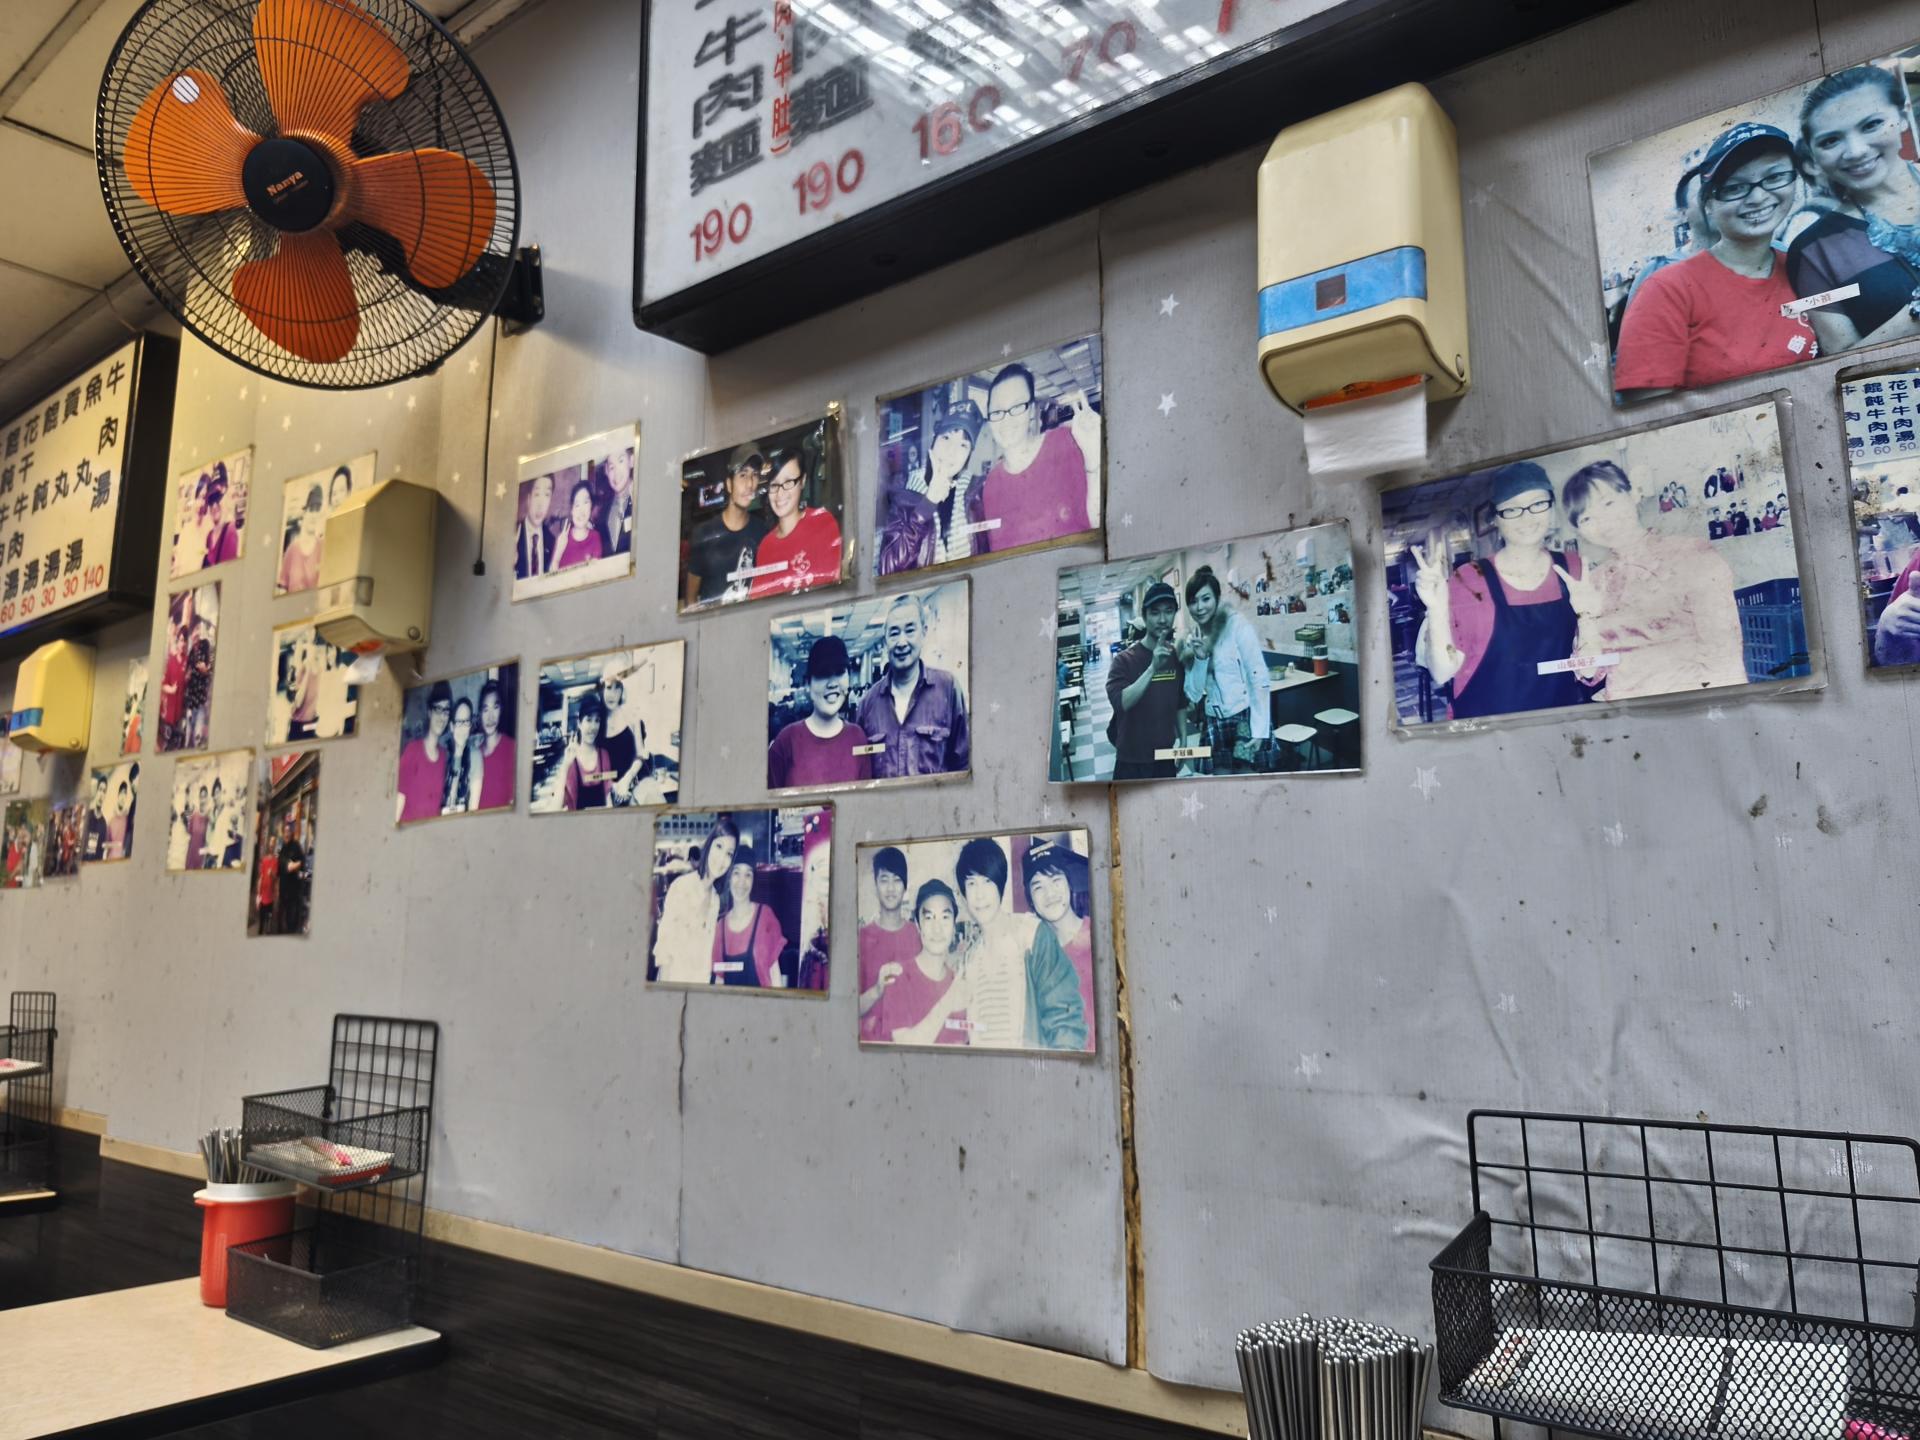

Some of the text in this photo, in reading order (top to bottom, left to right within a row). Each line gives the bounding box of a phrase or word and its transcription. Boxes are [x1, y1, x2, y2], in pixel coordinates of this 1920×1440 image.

[793, 148, 865, 215] 190
[690, 202, 753, 262] 190
[90, 360, 125, 512] 牛肉湯
[1899, 442, 1916, 452] 50
[1873, 445, 1891, 455] 60
[64, 373, 102, 576] 魚丸湯
[62, 576, 78, 598] 30
[83, 564, 104, 591] 140
[20, 595, 35, 617] 50
[41, 586, 56, 608] 30
[1, 602, 15, 623] 60
